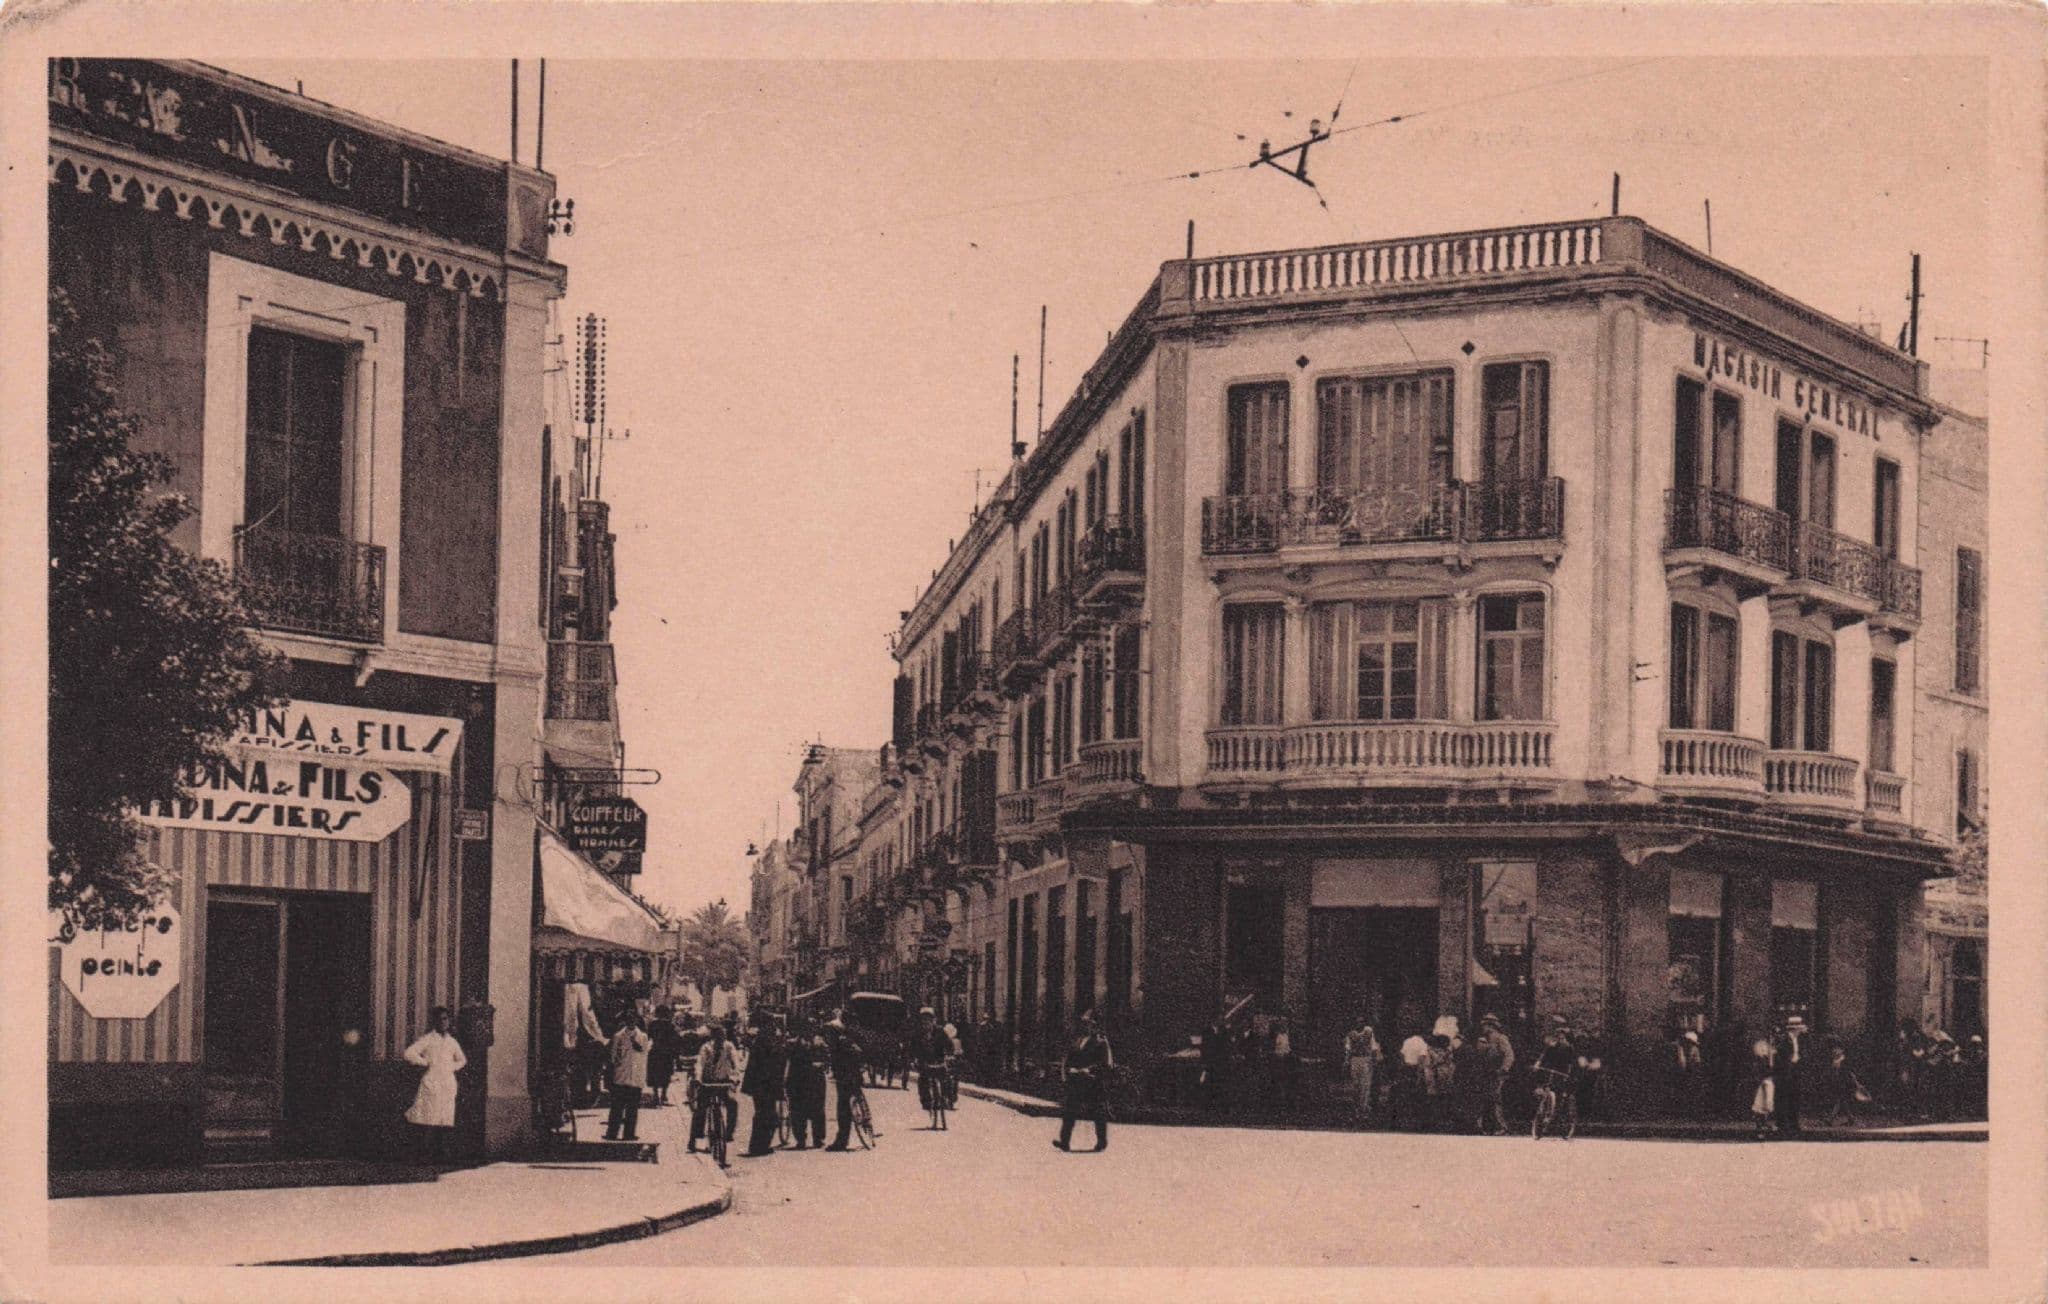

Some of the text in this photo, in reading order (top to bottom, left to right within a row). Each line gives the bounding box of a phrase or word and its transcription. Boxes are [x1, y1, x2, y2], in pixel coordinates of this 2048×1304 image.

[247, 704, 450, 753] INA & FILS
[271, 780, 295, 796] &
[299, 760, 383, 804] FILS
[572, 806, 641, 822] COIFFEUR
[80, 943, 162, 993] peints
